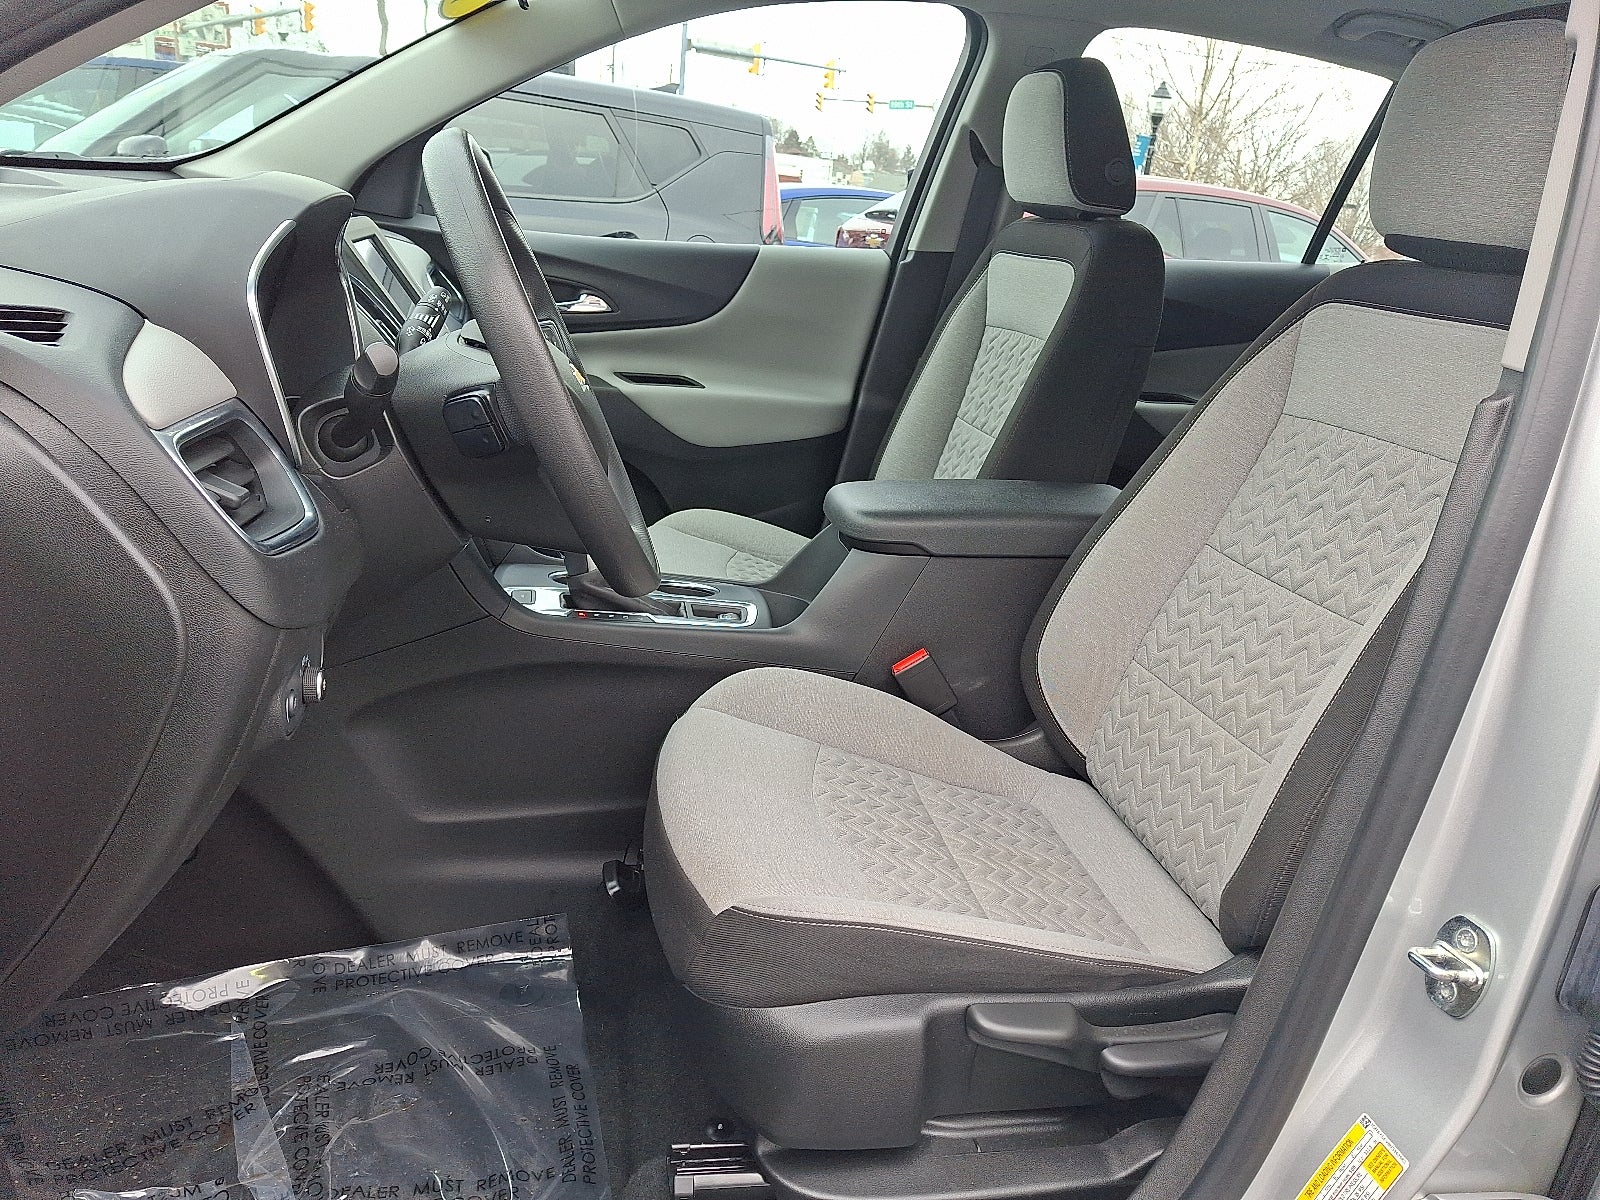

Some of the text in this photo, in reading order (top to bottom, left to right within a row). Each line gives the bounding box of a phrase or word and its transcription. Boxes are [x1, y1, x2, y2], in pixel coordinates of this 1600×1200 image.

[335, 953, 396, 975] DEALER
[406, 943, 447, 962] MUST
[456, 931, 524, 955] REMOVE
[335, 953, 494, 991] PROTECTIVE COVER
[6, 1001, 233, 1053] DEALER MUST REMOVE
[44, 983, 229, 1028] PROTECTIVE COVER
[336, 1055, 539, 1091] DEALER MUST REMOVE
[374, 1046, 431, 1075] COVER
[543, 1044, 577, 1184] DEALER MUST REMOVE
[566, 1063, 597, 1185] PROTECTIVE COVER
[46, 1142, 128, 1171] DEALER
[142, 1116, 194, 1145] MUST
[1315, 1162, 1335, 1183] LOADING
[1328, 1137, 1354, 1166] INFORMATION
[413, 1178, 465, 1197] MUST
[477, 1166, 556, 1191] REMOVE
